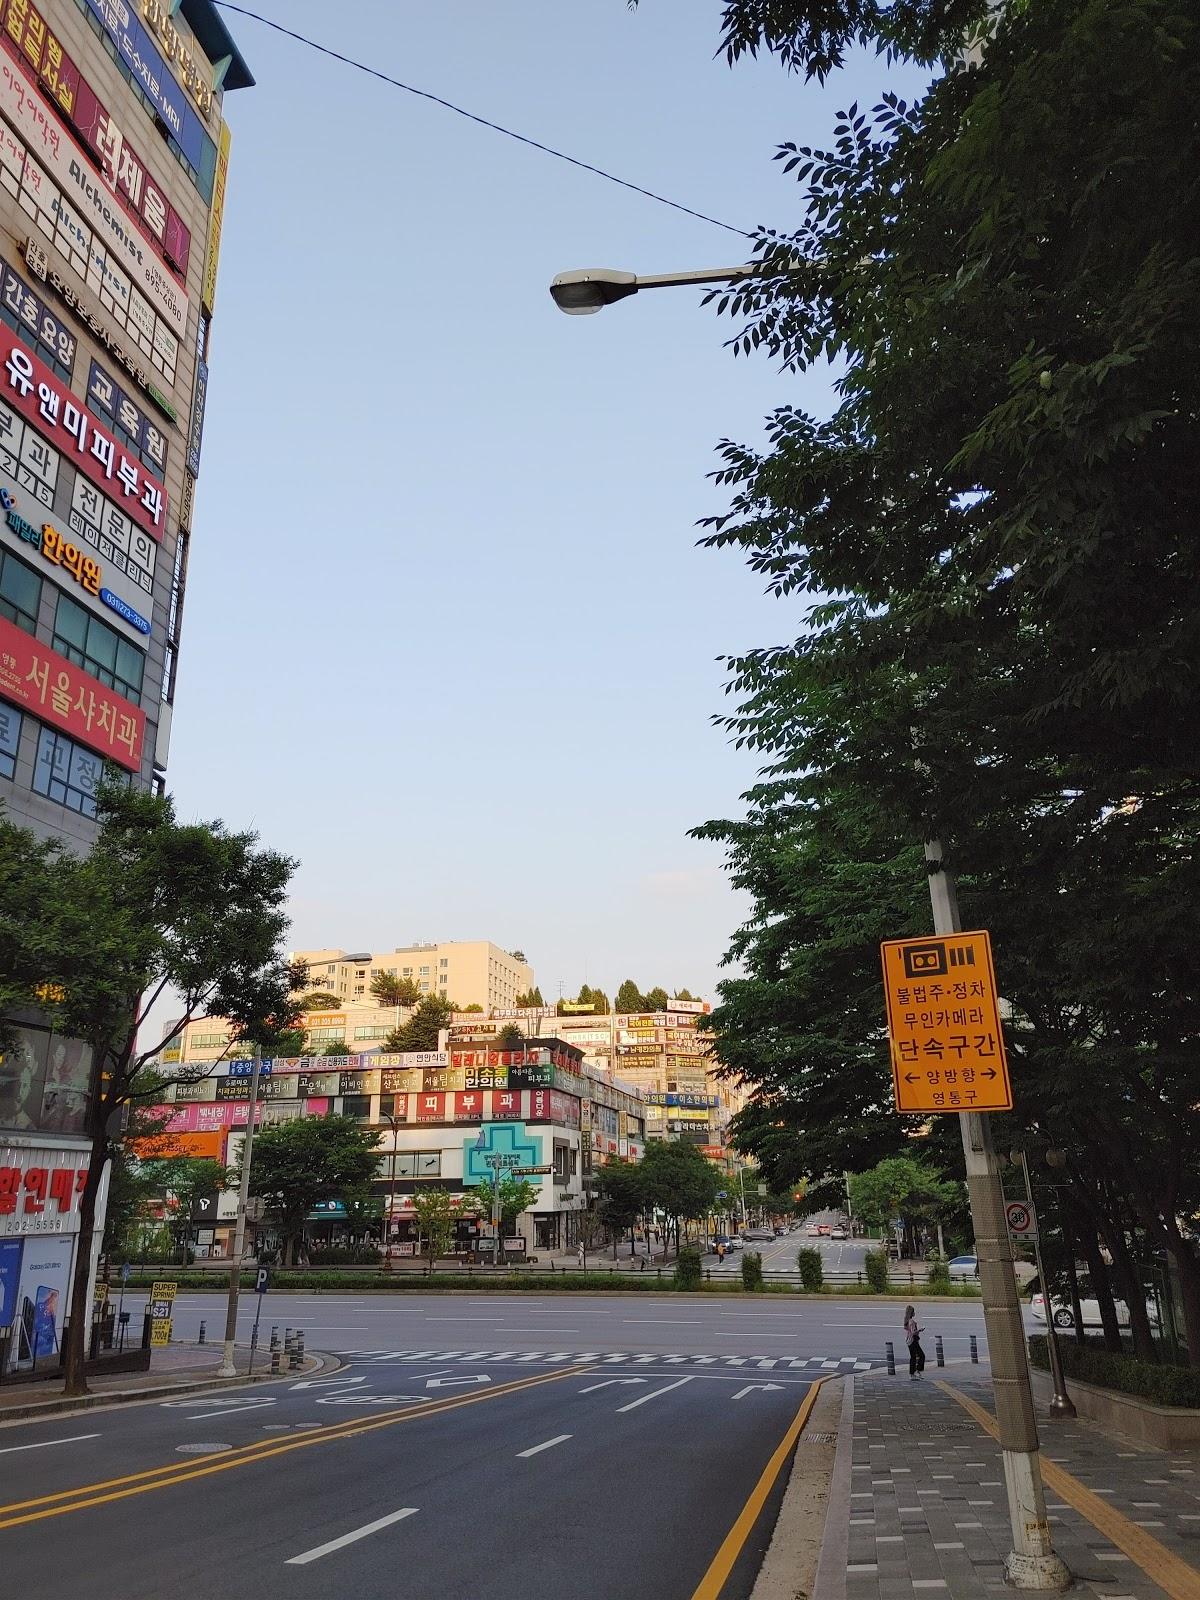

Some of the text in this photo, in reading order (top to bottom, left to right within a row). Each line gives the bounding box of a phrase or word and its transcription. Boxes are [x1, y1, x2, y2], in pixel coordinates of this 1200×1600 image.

[69, 159, 144, 267] Alchemist
[51, 196, 128, 300] Alchemist
[5, 347, 164, 527] 유앤미피부과
[79, 483, 152, 569] 전문의
[42, 524, 101, 598] 한의원
[896, 980, 985, 1005] 불법주·정차
[904, 1006, 983, 1030] 무인카메라
[898, 1033, 996, 1062] 단속구간
[369, 1055, 400, 1066] 게임장
[466, 1067, 507, 1077] 미소로
[528, 1075, 552, 1083] 피부과
[926, 1067, 975, 1085] 양방향
[466, 1077, 508, 1089] 한의원
[932, 1090, 978, 1106] 영통구
[199, 1105, 225, 1119] 백내장
[235, 1105, 261, 1118] 드림즈
[8, 1218, 62, 1232] 202-5556
[257, 1269, 268, 1289] P
[152, 1291, 176, 1299] SPRING
[154, 1284, 176, 1292] SUPER
[153, 1306, 169, 1317] S21
